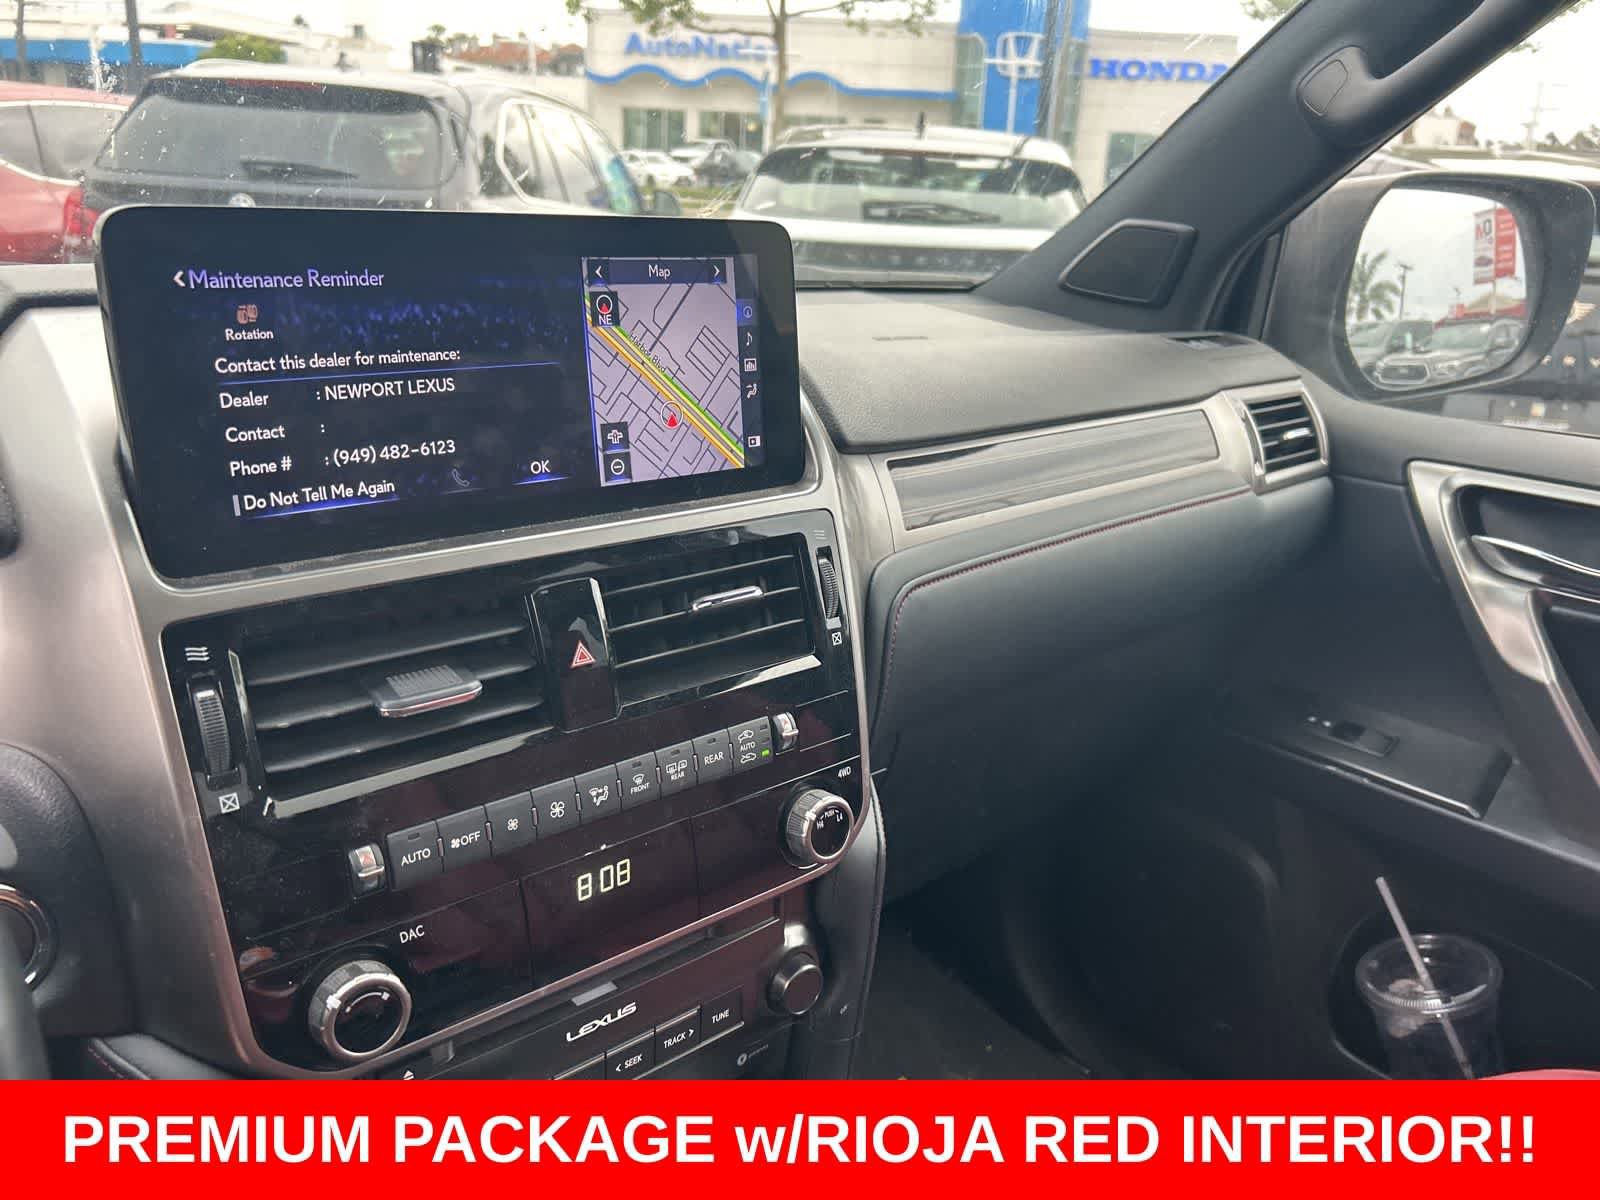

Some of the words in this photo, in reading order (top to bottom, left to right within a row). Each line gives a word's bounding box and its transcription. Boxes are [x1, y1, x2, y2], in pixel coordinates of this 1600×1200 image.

[188, 269, 304, 290] Maintenance
[307, 268, 385, 288] Reminder
[648, 263, 671, 280] Map
[598, 313, 613, 326] NE
[225, 327, 274, 341] Rotation
[214, 356, 277, 374] Contact
[279, 353, 306, 370] this
[309, 350, 352, 369] dealer
[354, 350, 375, 366] for
[378, 348, 461, 366] maintenance:
[219, 391, 270, 410] Dealer
[324, 380, 404, 401] NEWPORT
[408, 376, 456, 396] LEXUS
[225, 424, 286, 443] Contact
[229, 460, 278, 477] Phone
[280, 455, 292, 472] #
[333, 445, 377, 468] (949)
[379, 438, 456, 460] 482-6123
[530, 459, 551, 475] OK
[243, 494, 267, 512] Do
[270, 490, 298, 508] Not
[301, 486, 328, 503] Tell
[331, 484, 354, 501] Me
[357, 478, 396, 500] Again
[739, 740, 756, 752] AUTO
[703, 751, 725, 766] REAR
[837, 766, 852, 779] 4WD
[630, 781, 650, 795] FRONT
[460, 829, 481, 847] OFF
[400, 846, 432, 868] AUTO
[399, 924, 425, 944] DAC
[565, 1001, 638, 1043] LEXUS
[711, 1008, 731, 1025] TUNE
[663, 1032, 688, 1050] TRACK
[624, 1052, 644, 1070] SEEK
